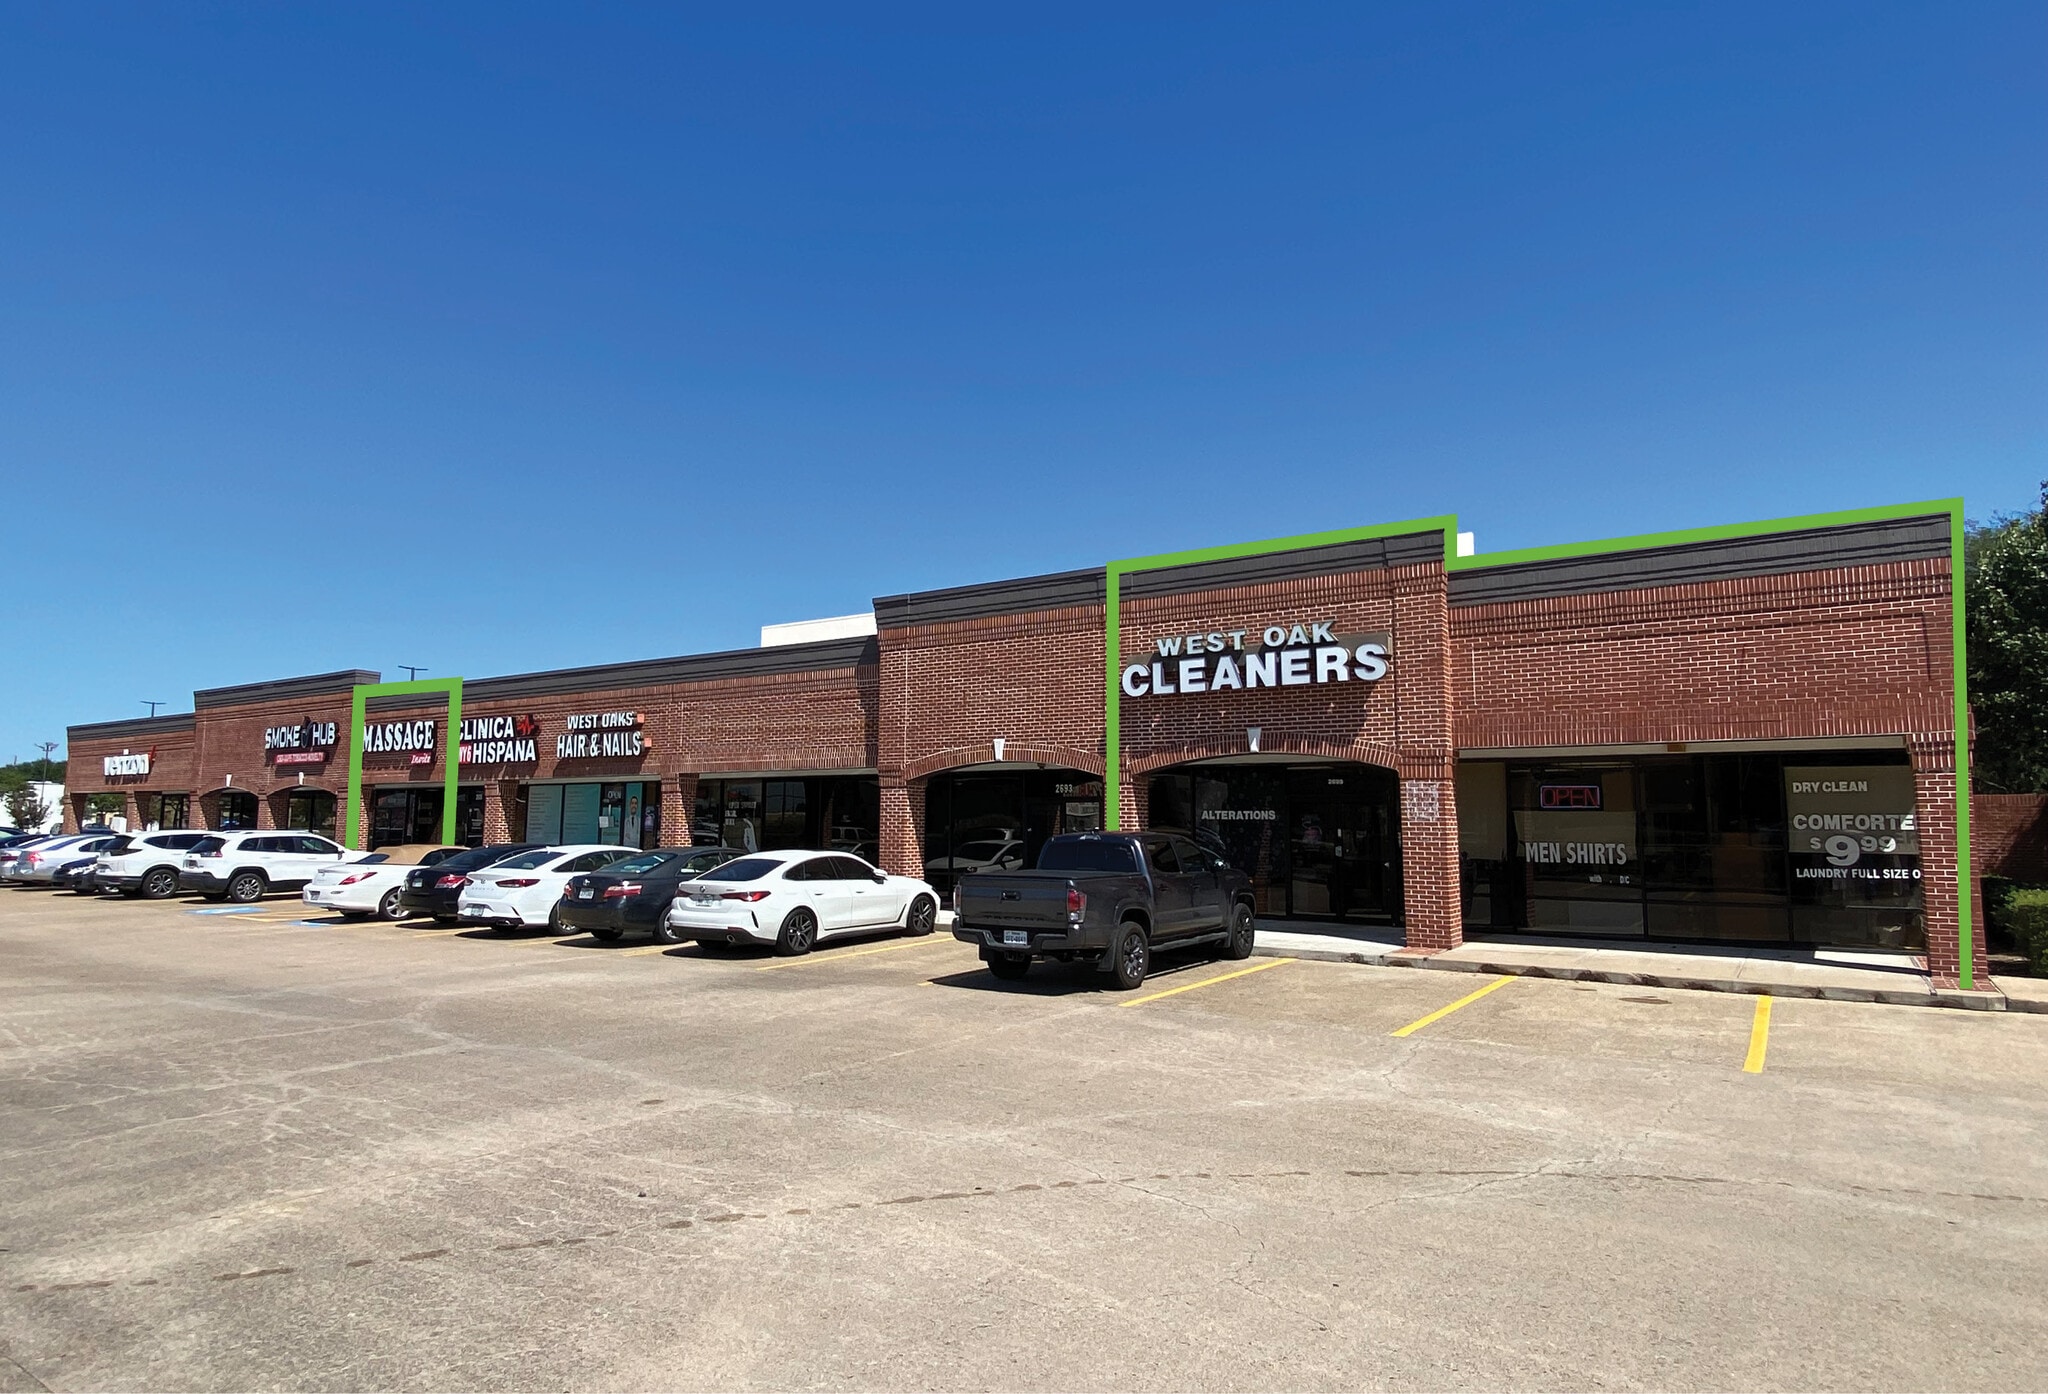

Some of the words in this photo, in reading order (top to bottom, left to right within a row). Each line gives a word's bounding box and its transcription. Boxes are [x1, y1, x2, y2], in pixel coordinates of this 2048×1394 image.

[1156, 630, 1247, 657] WEST
[1262, 621, 1337, 647] OAK
[1121, 643, 1390, 698] CLEANERS
[567, 714, 599, 730] WEST
[601, 711, 634, 728] OAKS
[265, 725, 300, 749] SMOKE
[312, 722, 335, 746] HUB
[363, 720, 434, 752] MASSAGE
[556, 734, 586, 758] HAIR
[590, 733, 601, 757] &
[602, 731, 641, 757] NAILS
[472, 740, 536, 764] HISPANA
[1055, 783, 1073, 793] 2693
[1542, 788, 1598, 807] OPEN
[1792, 782, 1820, 793] DRY
[1822, 781, 1868, 792] CLEAN
[1201, 810, 1276, 820] ALTERATIONS
[1525, 842, 1561, 863] MEN
[1566, 842, 1627, 865] SHIRTS
[1796, 868, 1848, 878] LAUNDRY
[1851, 868, 1880, 879] FULL
[1882, 868, 1909, 879] SIZE
